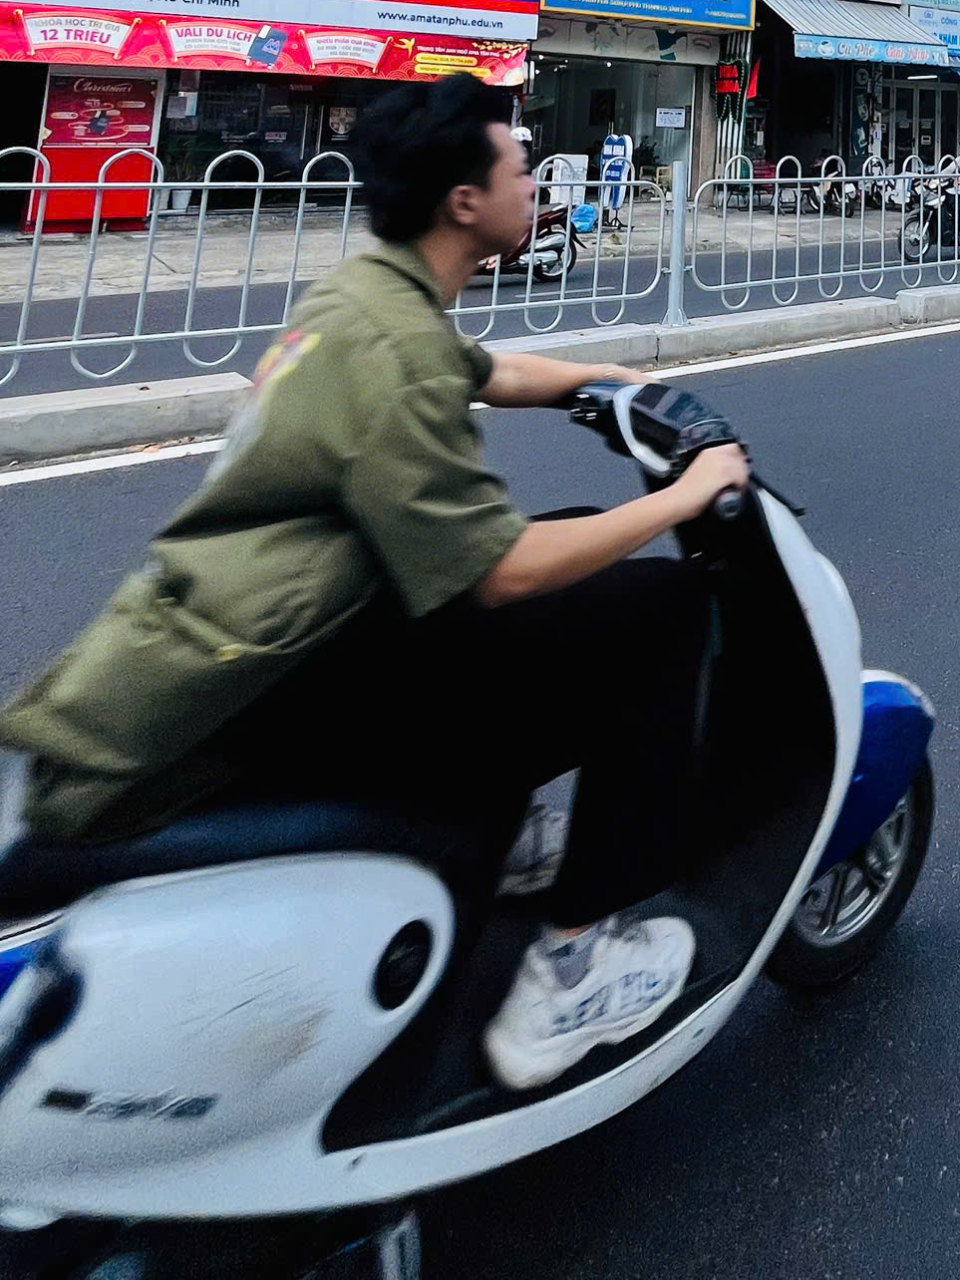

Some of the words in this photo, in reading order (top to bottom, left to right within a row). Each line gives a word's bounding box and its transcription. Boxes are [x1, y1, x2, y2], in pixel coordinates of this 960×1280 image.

[377, 11, 504, 29] www.amatanphu.edu.vn
[40, 28, 59, 41] 12
[175, 27, 202, 38] VALI
[206, 28, 224, 38] DU
